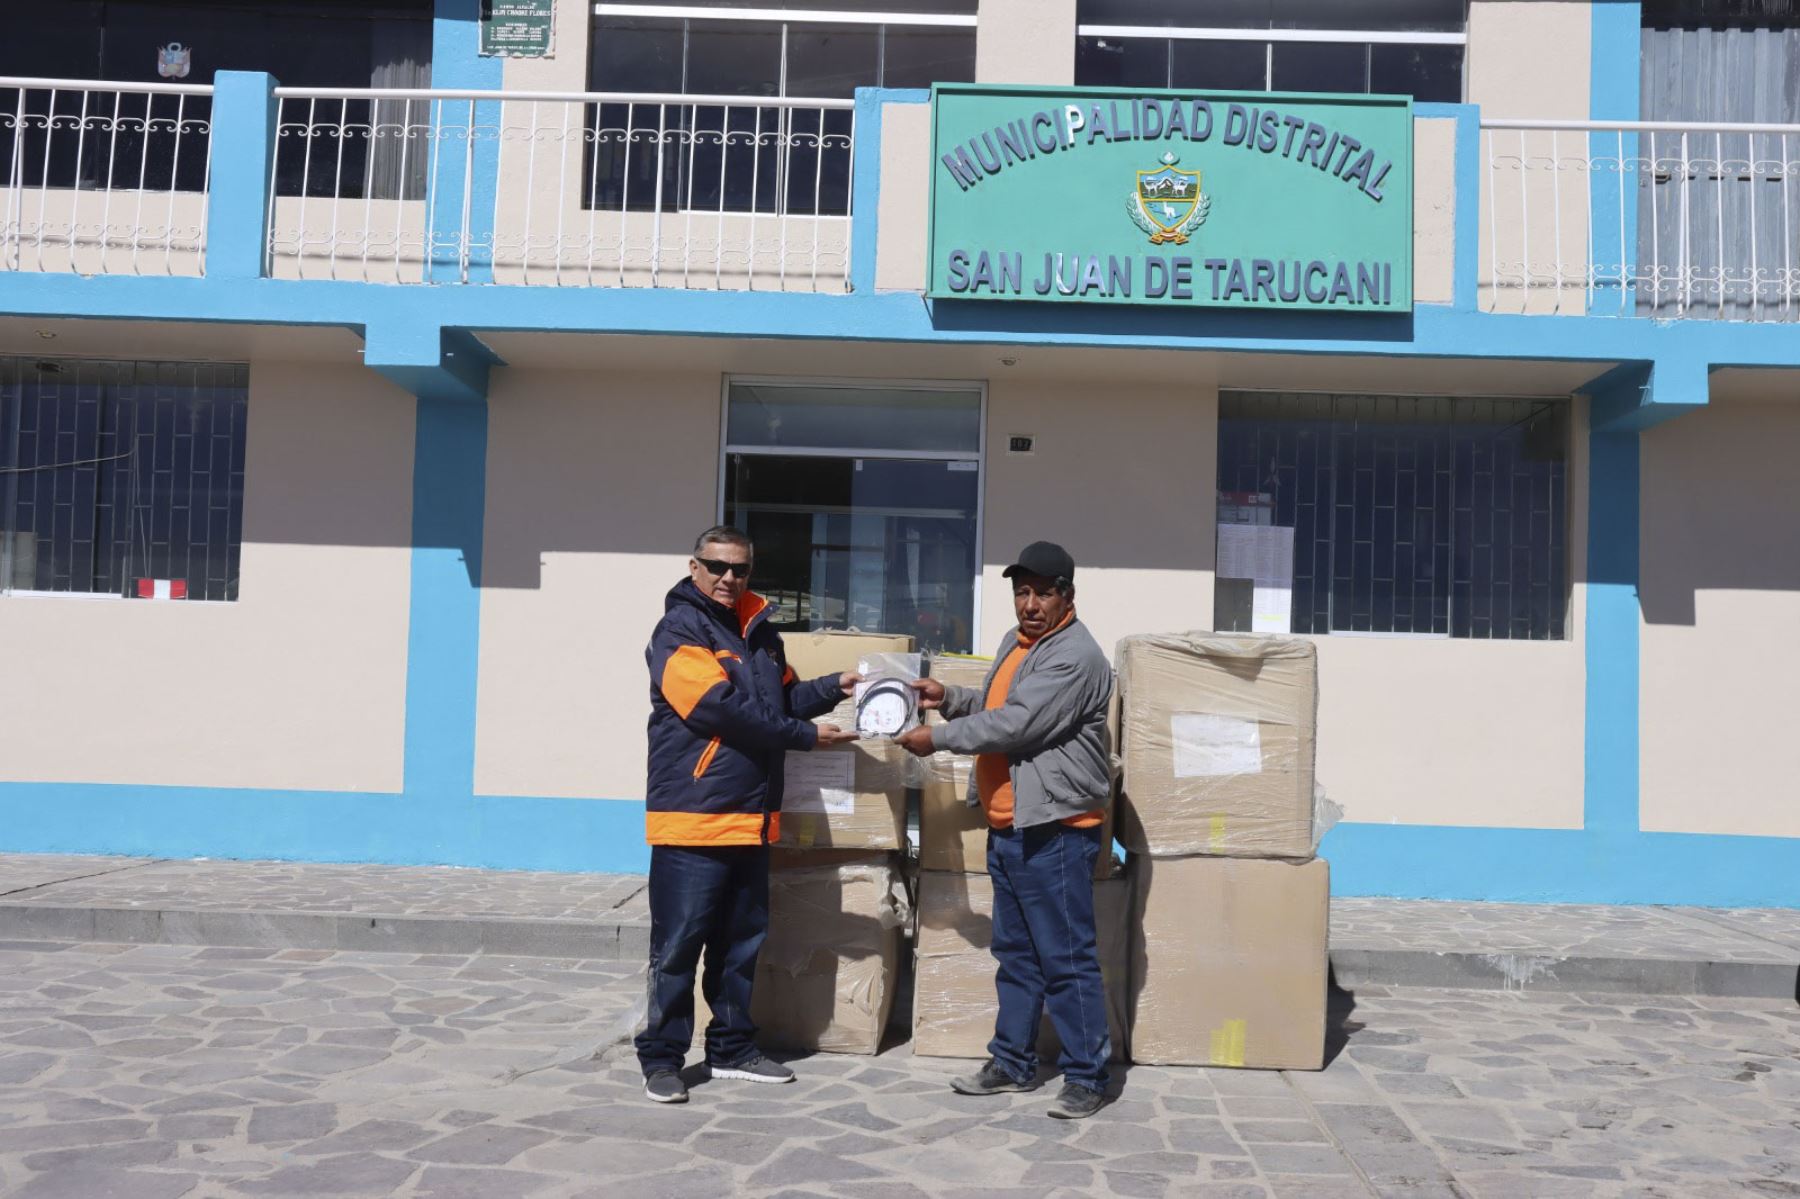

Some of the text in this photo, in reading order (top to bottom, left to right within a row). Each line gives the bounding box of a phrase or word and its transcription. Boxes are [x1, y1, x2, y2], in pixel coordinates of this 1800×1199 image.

[941, 98, 1392, 203] MUNICIPALIDAD DISTRITAL
[947, 249, 1391, 305] SAN JUAN DE TARUCANI
